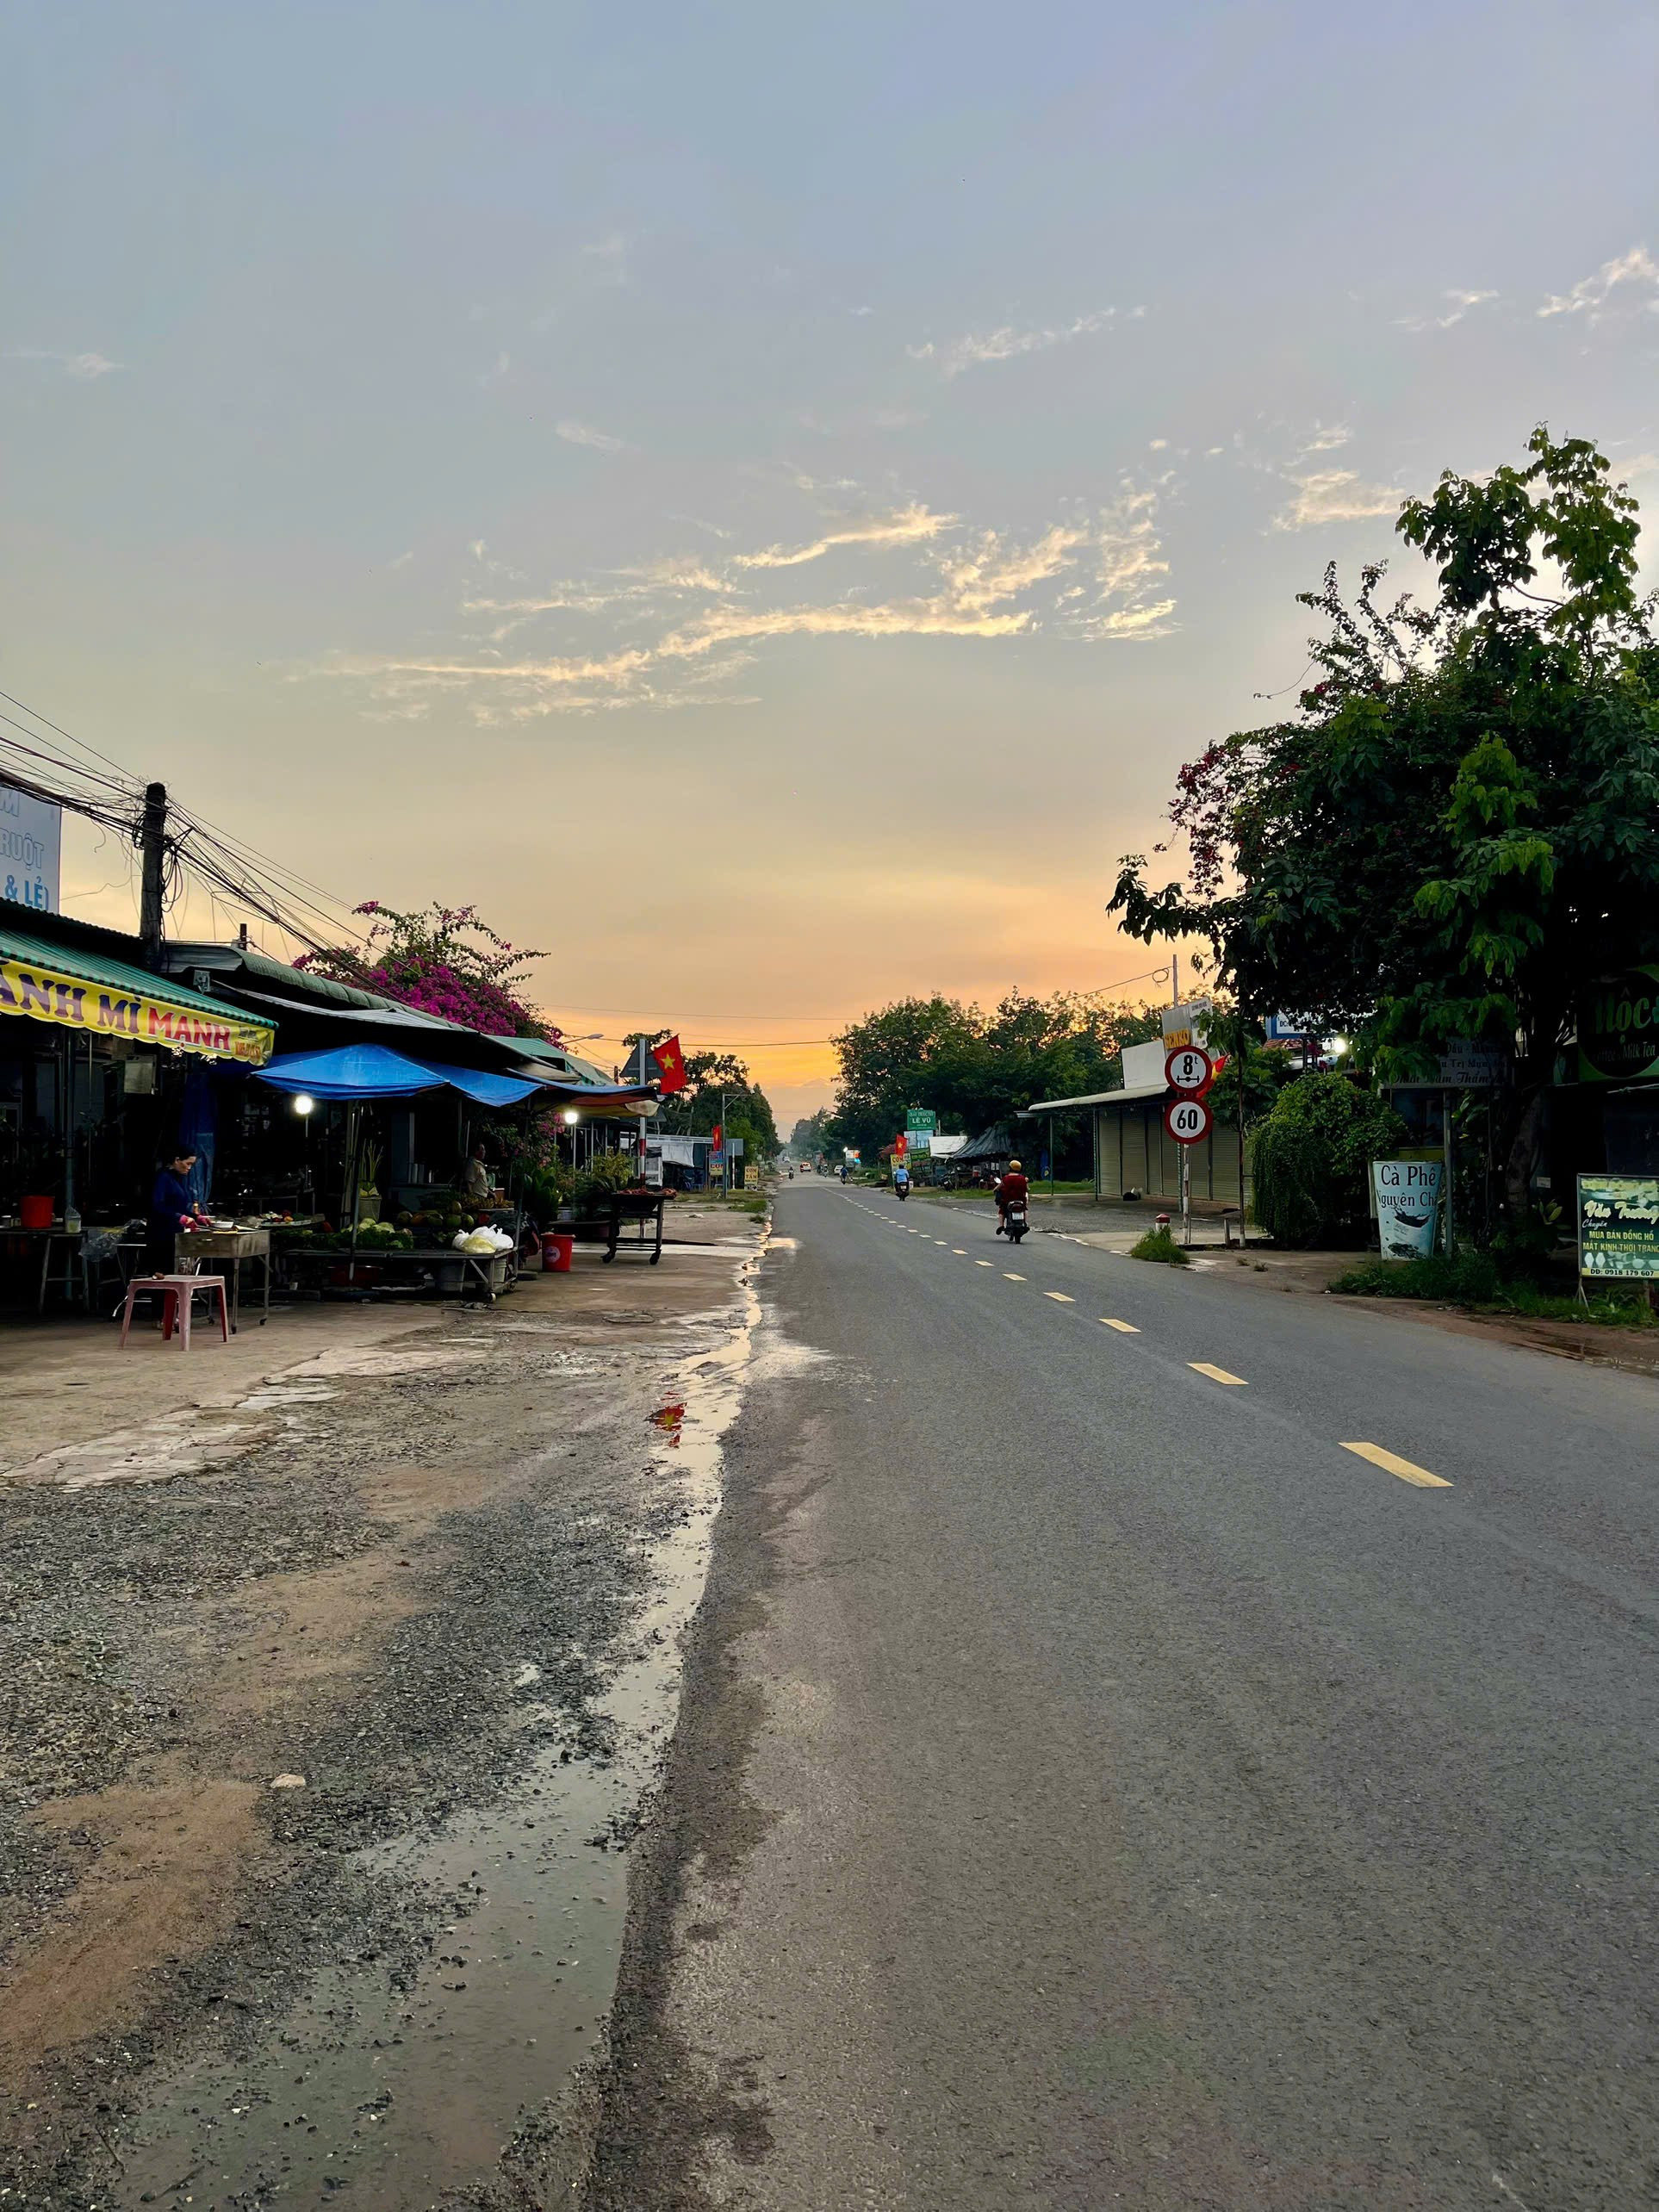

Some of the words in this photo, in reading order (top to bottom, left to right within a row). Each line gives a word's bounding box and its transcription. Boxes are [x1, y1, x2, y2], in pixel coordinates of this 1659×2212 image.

[97, 995, 141, 1035] MÌ
[148, 1006, 231, 1051] MẠNH
[1642, 1041, 1656, 1059] Tea
[1177, 1109, 1198, 1130] 60
[1381, 1165, 1400, 1186] Cà
[1406, 1165, 1436, 1186] Phê
[1588, 1230, 1605, 1240] MUA
[1606, 1229, 1621, 1240] BÁN
